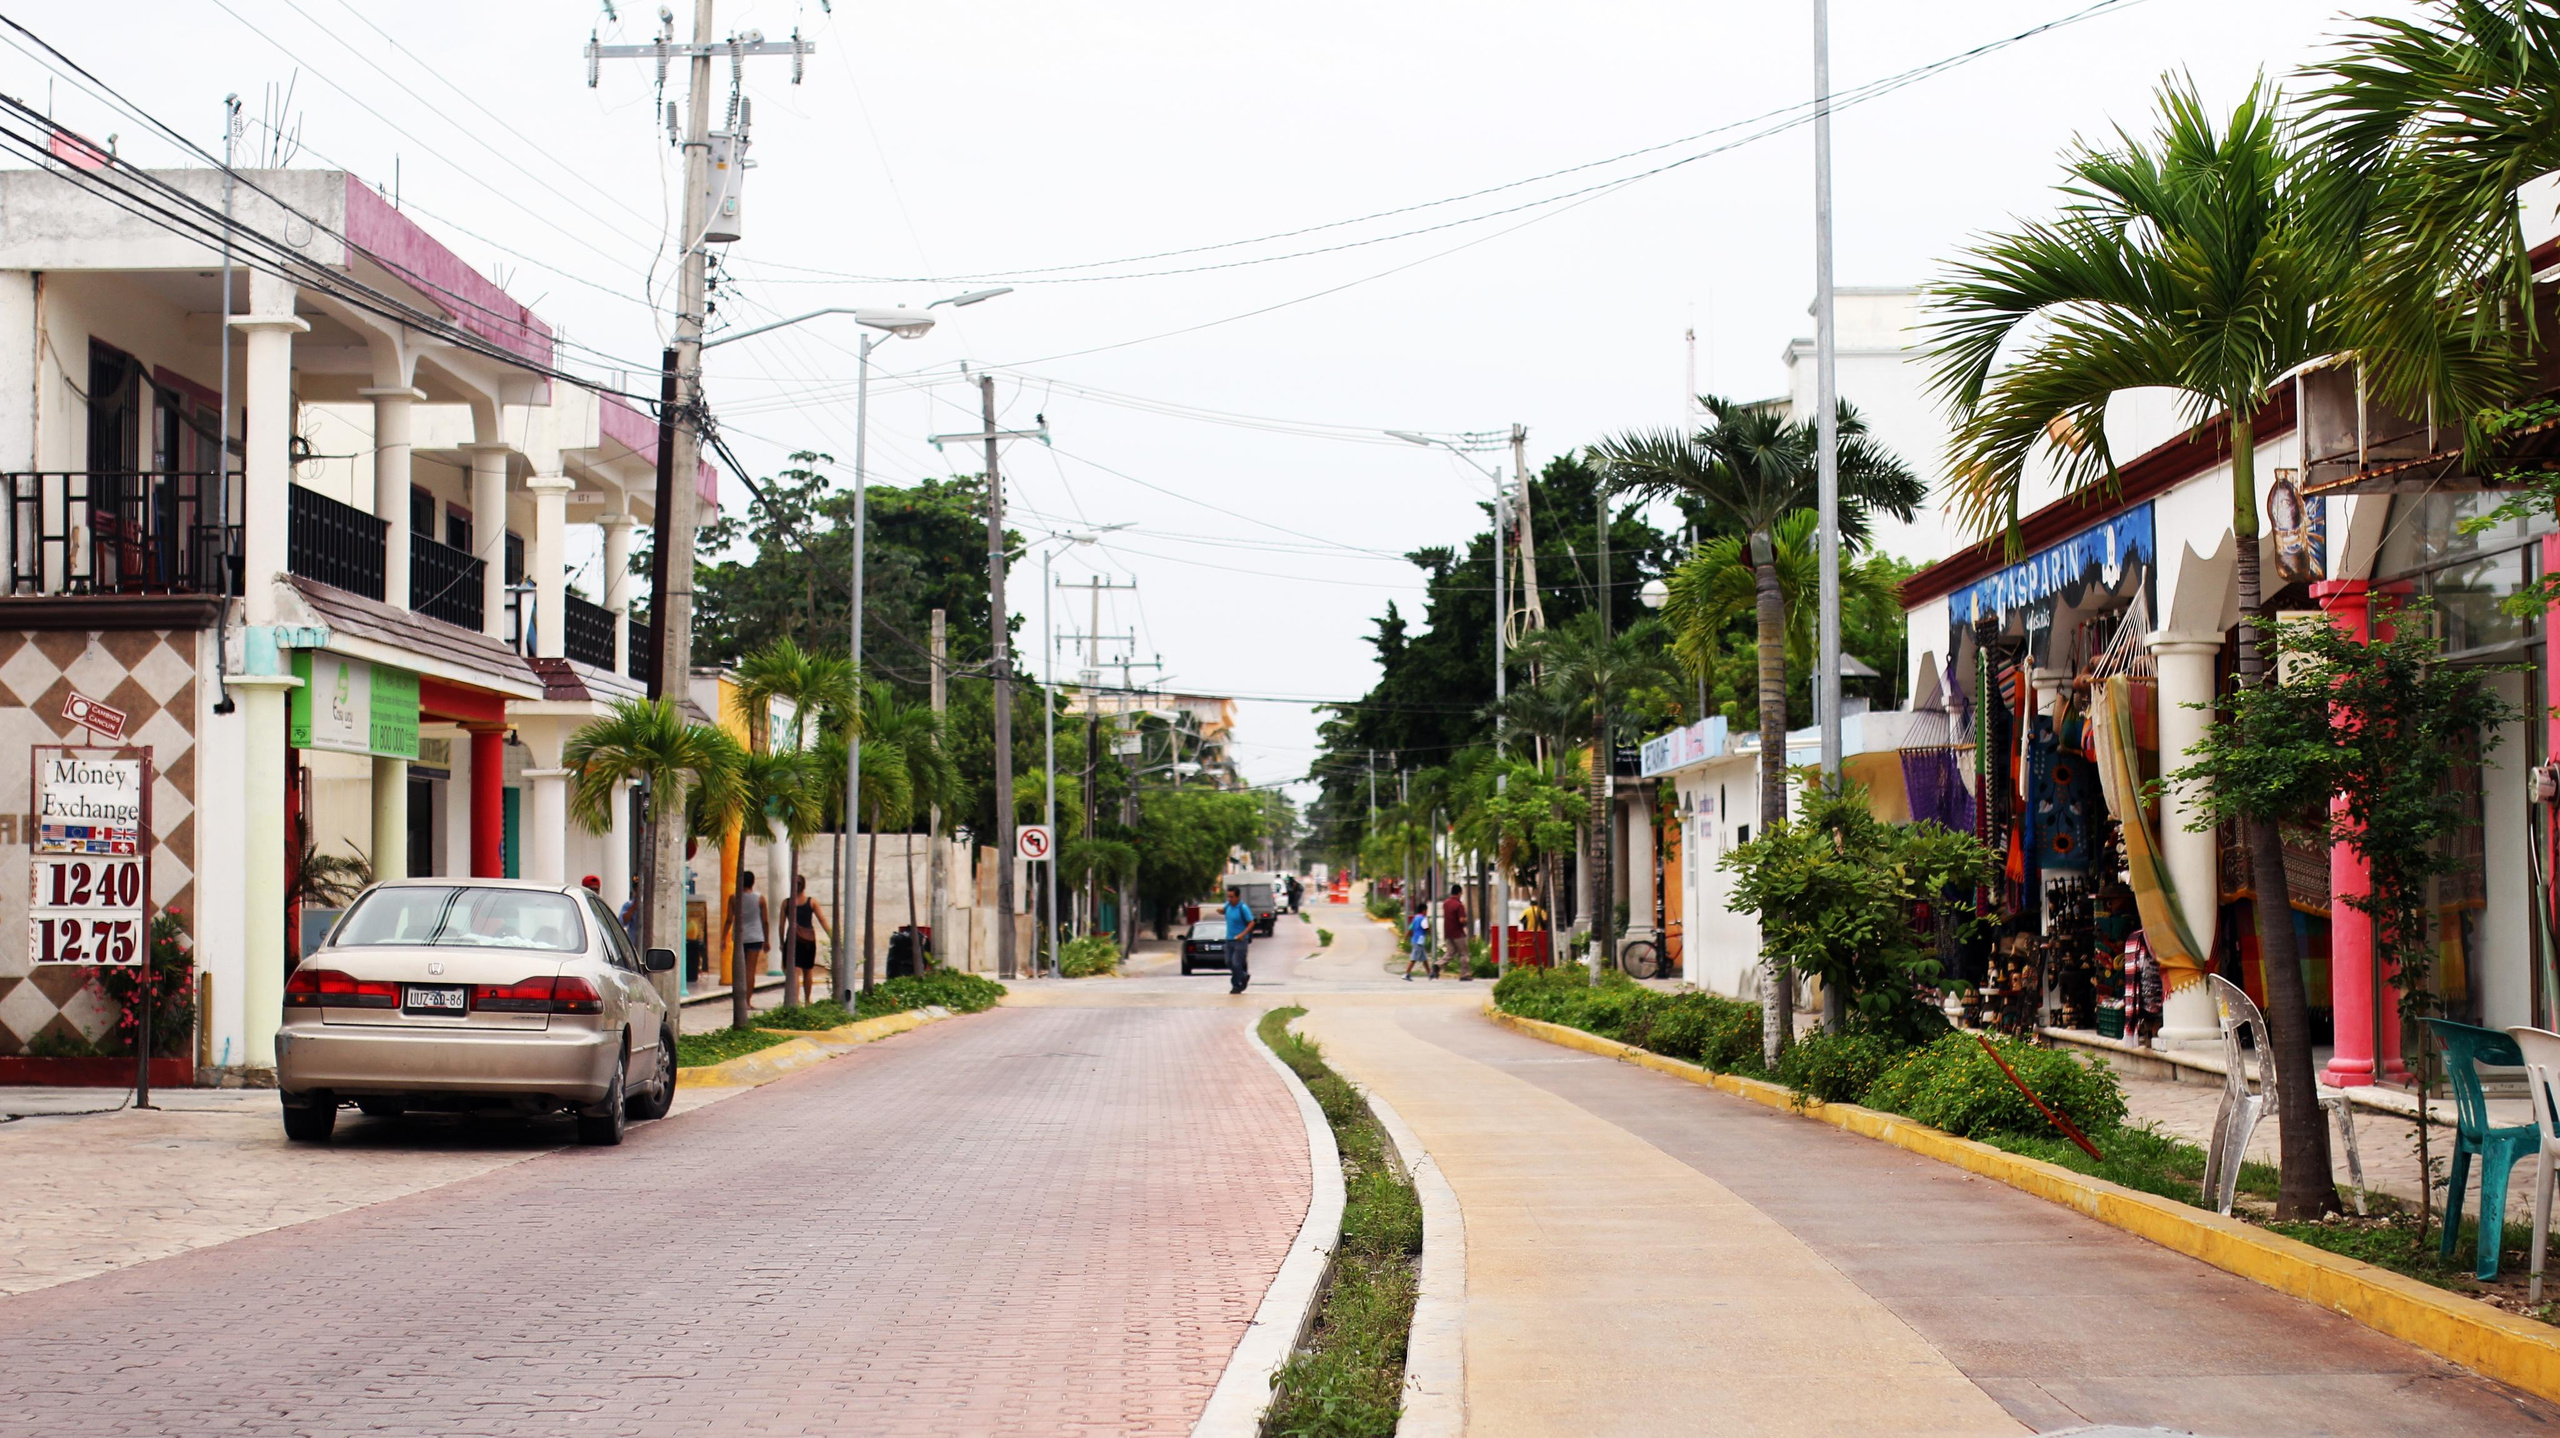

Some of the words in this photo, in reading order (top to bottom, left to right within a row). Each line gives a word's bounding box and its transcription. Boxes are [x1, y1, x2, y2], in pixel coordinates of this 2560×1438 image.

[88, 714, 116, 731] CANCUN
[91, 705, 121, 723] CAMBIOS
[54, 760, 127, 791] Money
[42, 793, 139, 825] Exchange
[38, 918, 137, 963] 12.75
